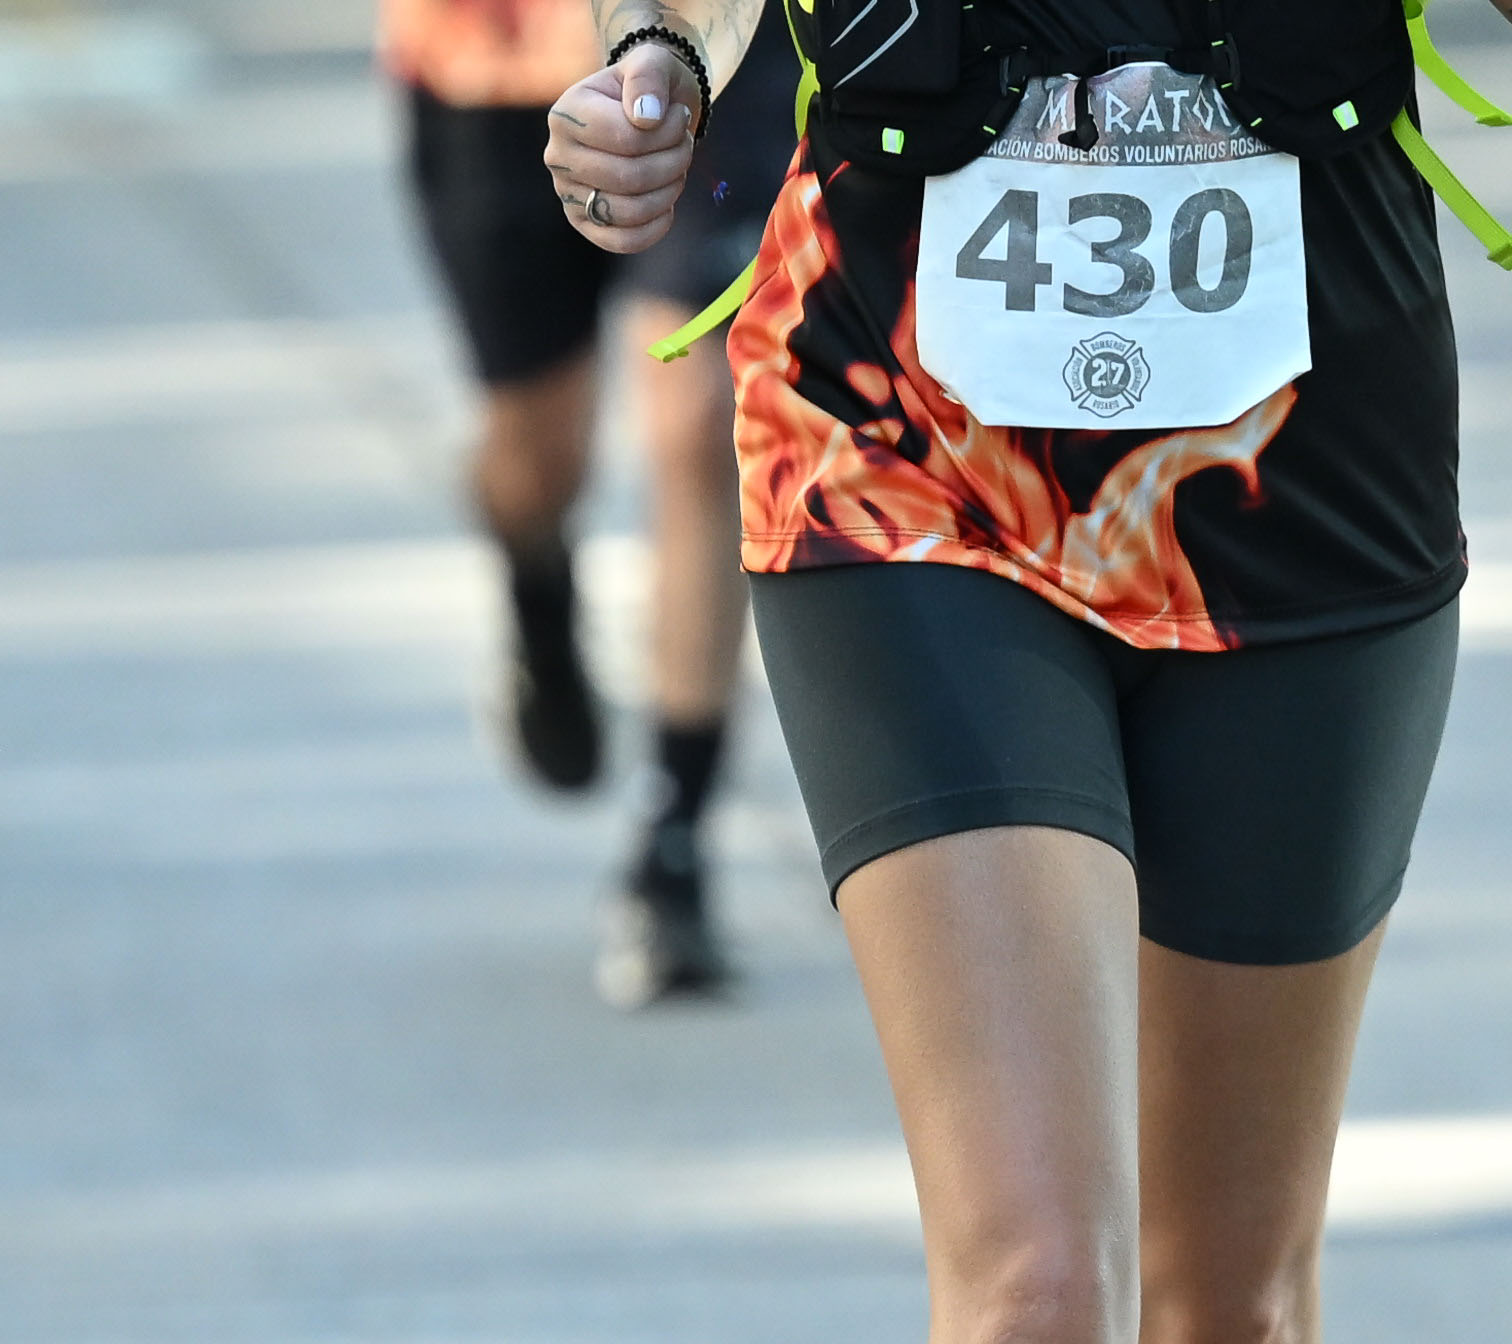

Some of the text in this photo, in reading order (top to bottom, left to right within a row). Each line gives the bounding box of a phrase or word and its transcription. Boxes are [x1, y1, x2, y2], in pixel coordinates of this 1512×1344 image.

[986, 135, 1032, 159] ACIÓN
[1033, 141, 1120, 163] BOMBEROS
[1124, 140, 1227, 163] VOLUNTARIOS
[956, 188, 1253, 318] 430
[1091, 357, 1125, 387] 27
